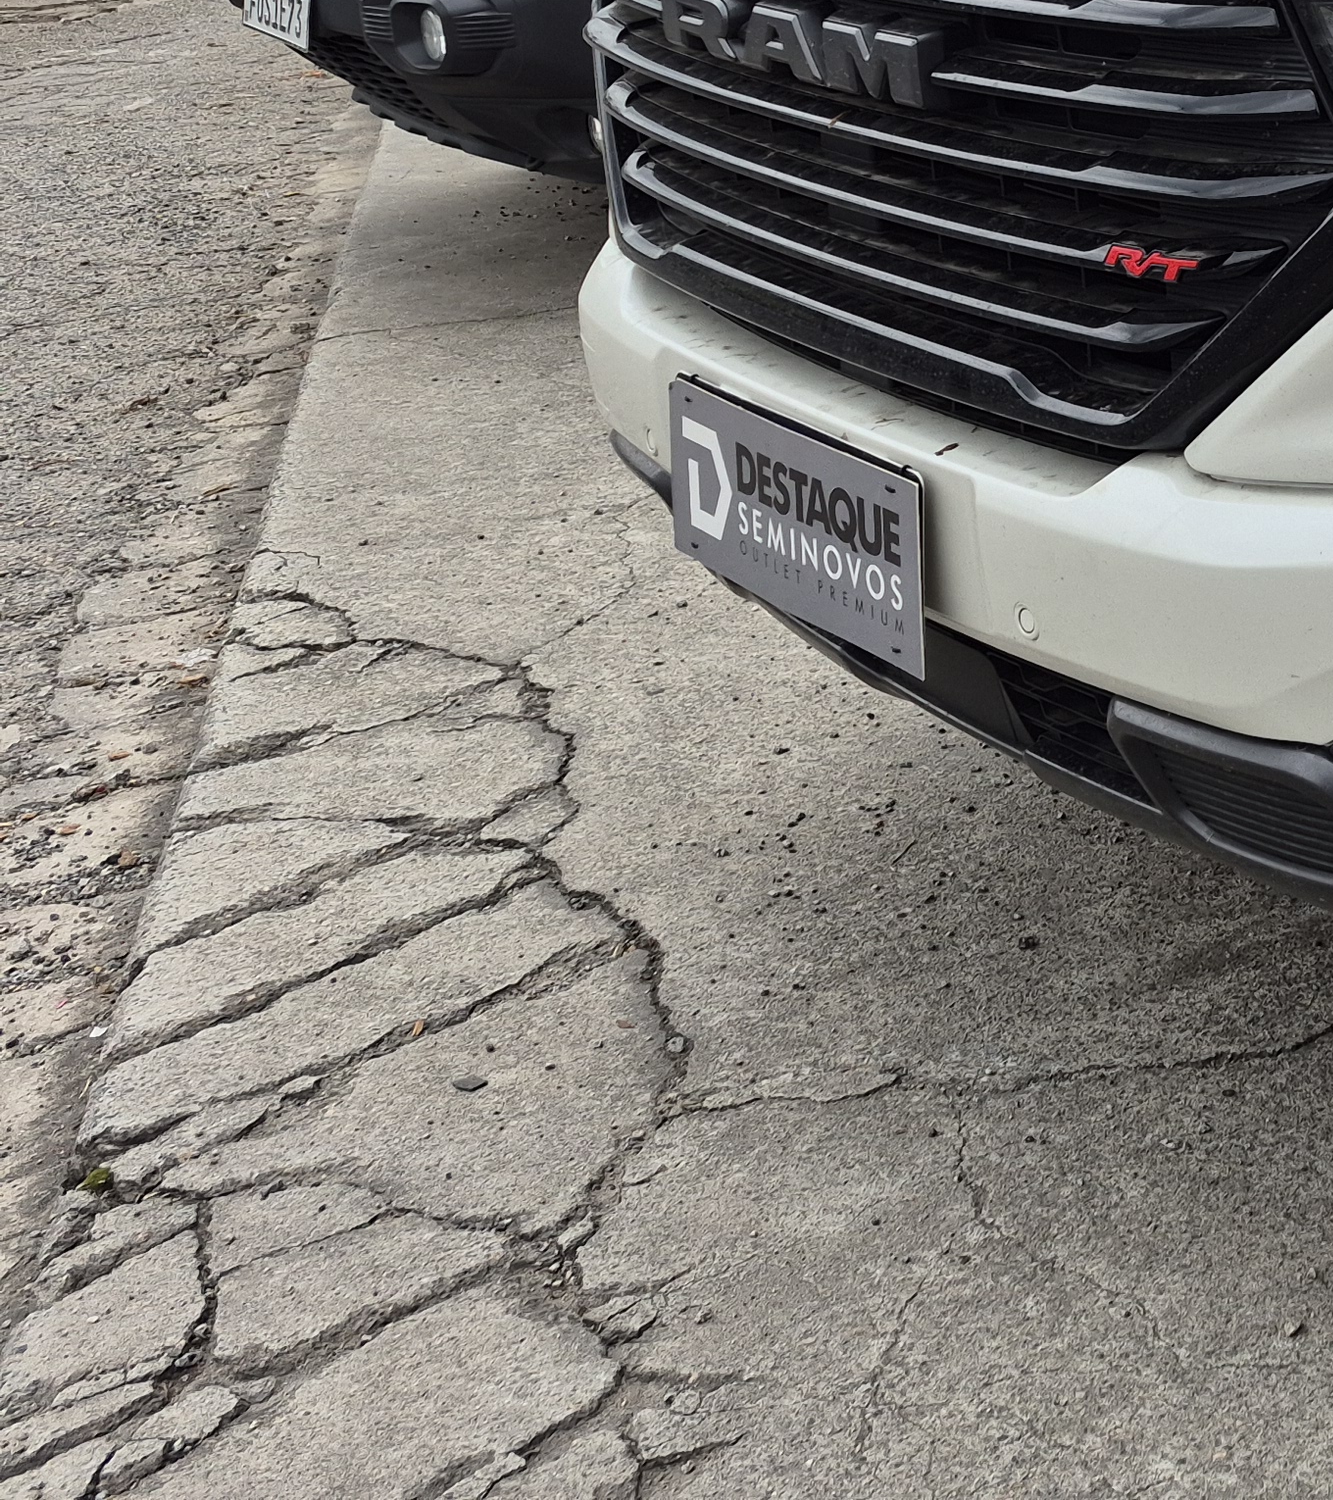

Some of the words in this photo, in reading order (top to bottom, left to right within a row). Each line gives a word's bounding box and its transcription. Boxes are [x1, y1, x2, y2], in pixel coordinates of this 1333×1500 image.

[1102, 243, 1199, 284] R/T
[734, 441, 902, 568] DESTAQUE
[737, 501, 903, 612] SEMINOVOS
[739, 540, 802, 585] OUTLET
[817, 579, 906, 636] PREMIUM
